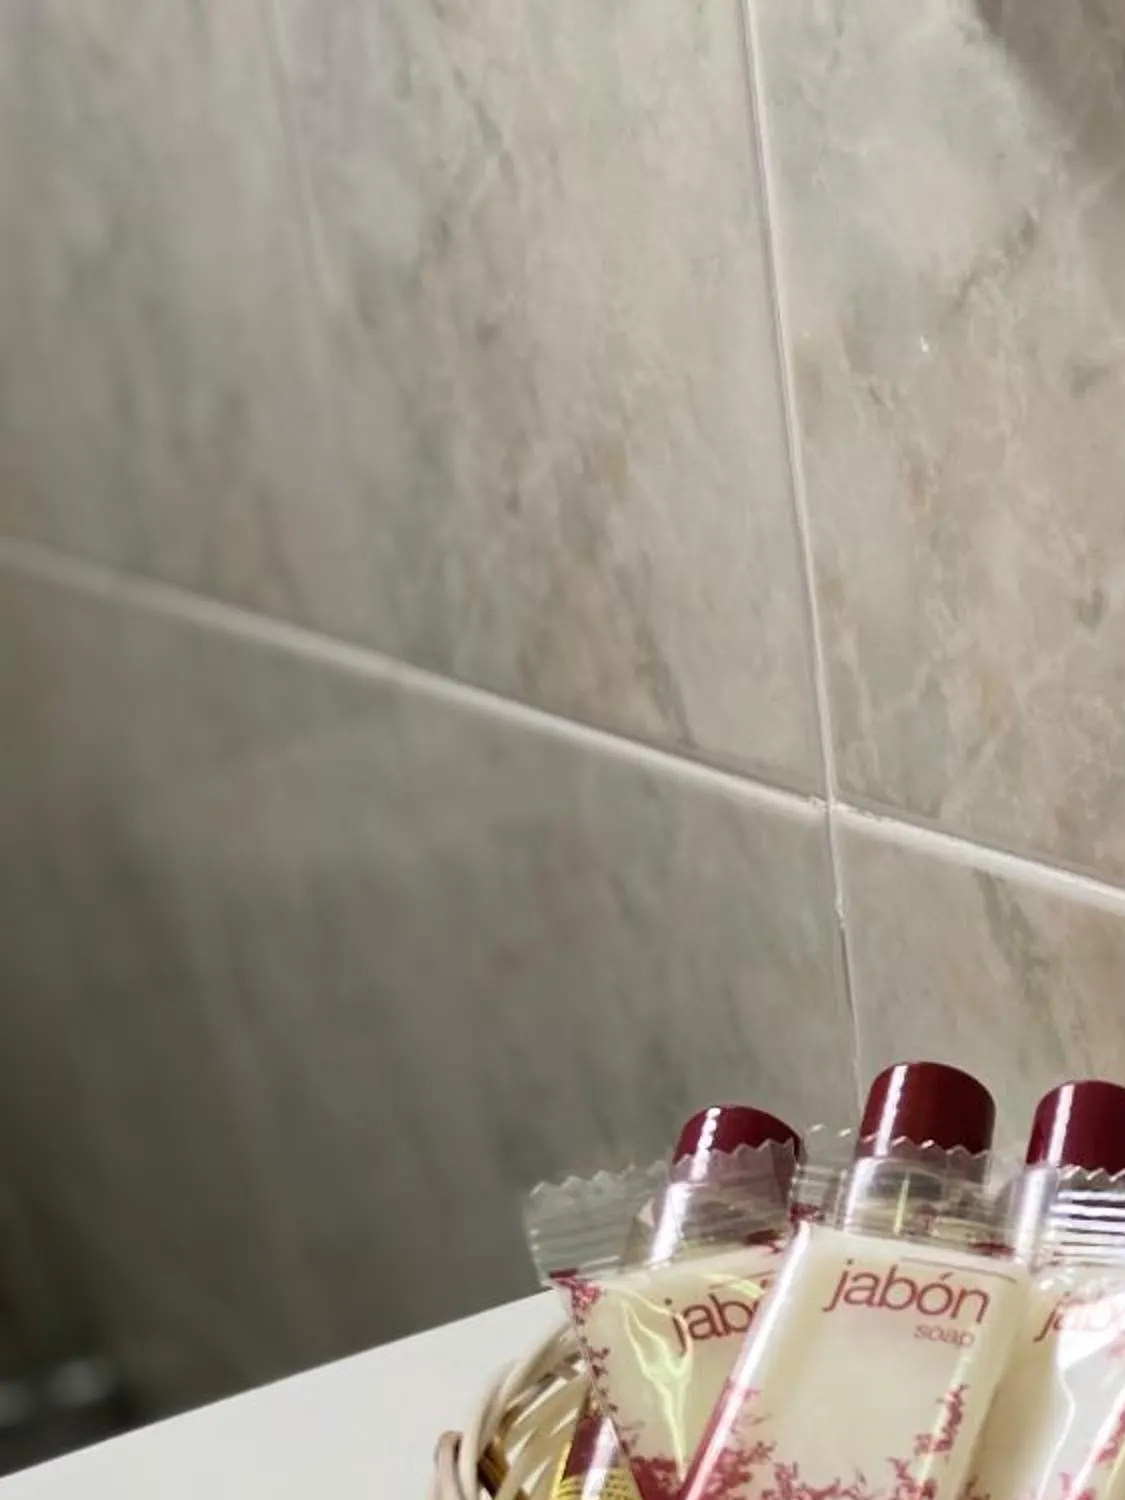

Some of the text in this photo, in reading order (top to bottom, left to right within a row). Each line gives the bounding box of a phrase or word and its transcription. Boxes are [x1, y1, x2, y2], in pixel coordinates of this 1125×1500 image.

[664, 1279, 769, 1358] jab
[822, 1259, 990, 1324] jabón
[913, 1323, 976, 1349] soap
